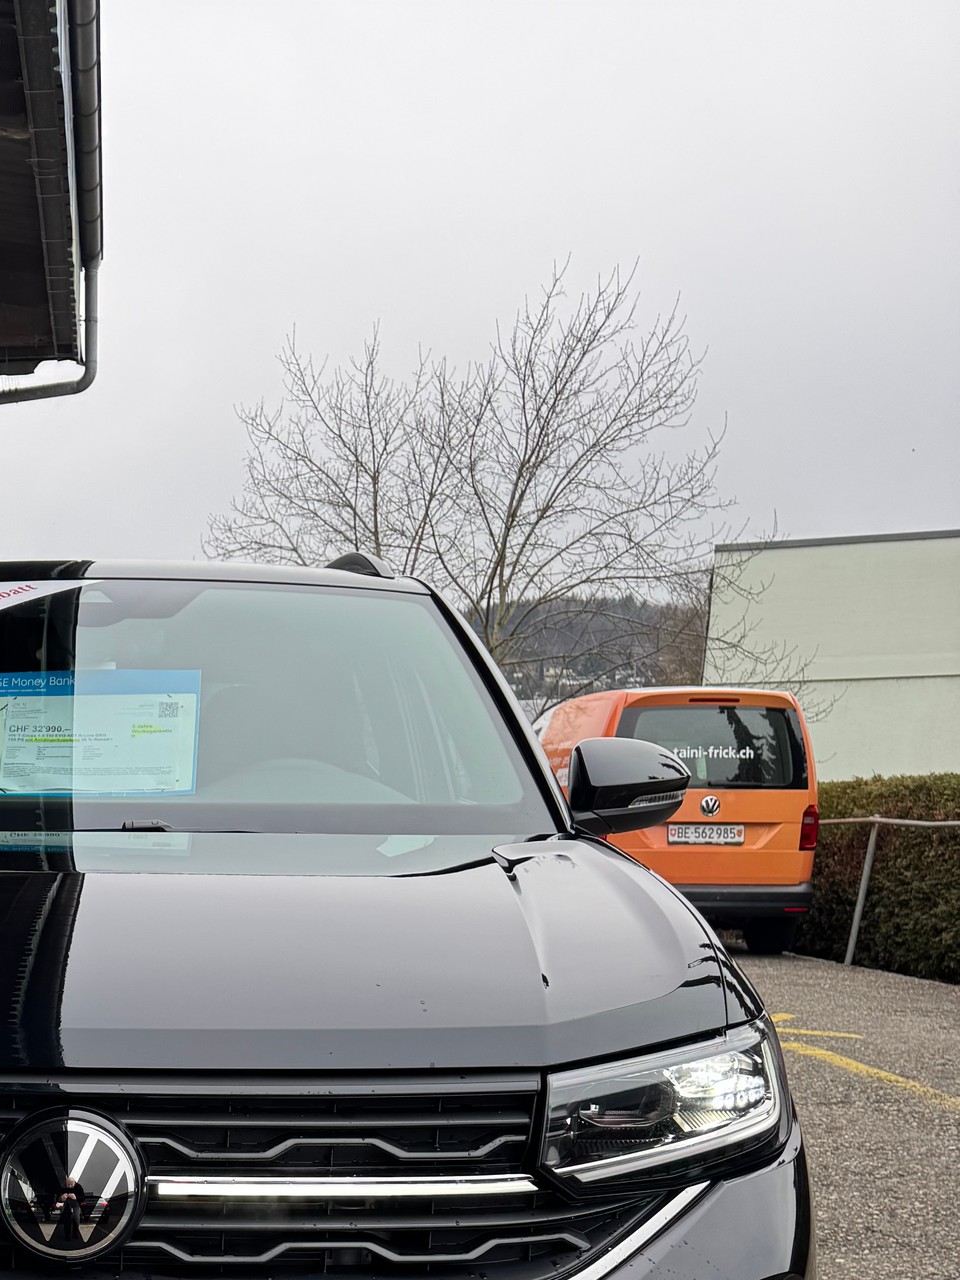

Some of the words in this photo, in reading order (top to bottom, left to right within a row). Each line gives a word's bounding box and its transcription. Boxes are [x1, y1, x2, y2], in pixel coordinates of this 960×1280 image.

[11, 678, 47, 688] Money
[49, 676, 75, 686] Bank
[9, 724, 29, 733] CHF
